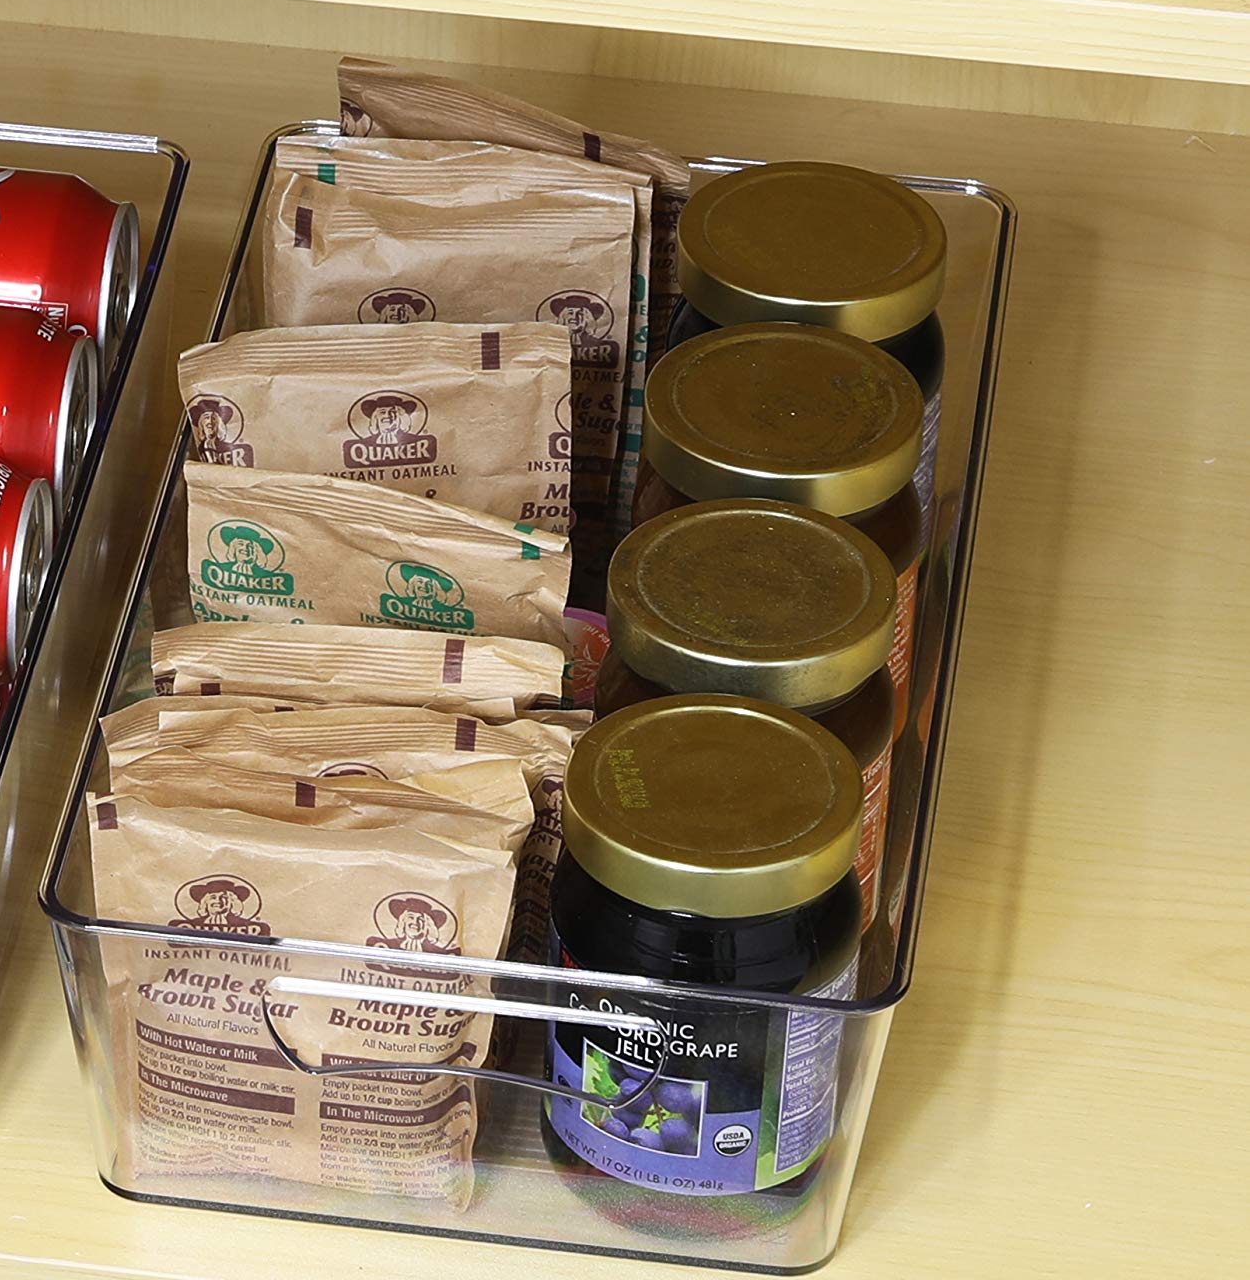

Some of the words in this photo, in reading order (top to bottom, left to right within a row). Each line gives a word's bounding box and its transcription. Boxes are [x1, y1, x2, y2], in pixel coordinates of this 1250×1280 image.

[349, 439, 431, 465] QUAKER
[391, 464, 457, 480] OATMEAL
[206, 567, 286, 592] QUAKER
[246, 594, 316, 611] OATMEAL
[385, 598, 468, 625] QUAKER
[144, 948, 213, 961] INSTANT
[219, 951, 293, 972] OATMEAL
[163, 968, 244, 994] Maple
[249, 978, 272, 997] &
[340, 967, 406, 991] INSTANT
[137, 983, 216, 1011] Brown
[222, 994, 299, 1023] Sugar
[166, 1013, 181, 1024] All
[182, 1015, 220, 1029] Natural
[222, 1020, 260, 1036] Flavors
[327, 1007, 412, 1036] Brown
[140, 1025, 163, 1043] With
[164, 1036, 183, 1050] Hot
[185, 1040, 217, 1057] Water
[219, 1048, 231, 1058] or
[233, 1048, 259, 1062] Milk
[362, 1038, 377, 1049] All
[378, 1039, 417, 1053] Natural
[418, 1042, 454, 1054] Flavors
[669, 1040, 739, 1059] GRAPE
[159, 1050, 186, 1066] packet
[150, 1072, 169, 1089] The
[170, 1079, 229, 1102] Microwave
[321, 1088, 338, 1099] Add
[322, 1077, 350, 1090] Empty
[350, 1080, 380, 1094] packet
[381, 1083, 400, 1095] into
[158, 1094, 185, 1111] packet
[340, 1107, 361, 1120] The
[363, 1109, 426, 1124] Microwave
[320, 1122, 349, 1136] Empty
[350, 1126, 379, 1139] packet
[722, 1131, 745, 1141] USDA
[563, 1128, 581, 1147] NET
[581, 1143, 599, 1162] WT.
[601, 1156, 612, 1168] 17
[613, 1161, 632, 1177] OZ
[646, 1173, 660, 1183] LB
[672, 1177, 696, 1190] OZ)
[698, 1180, 724, 1191] 481g
